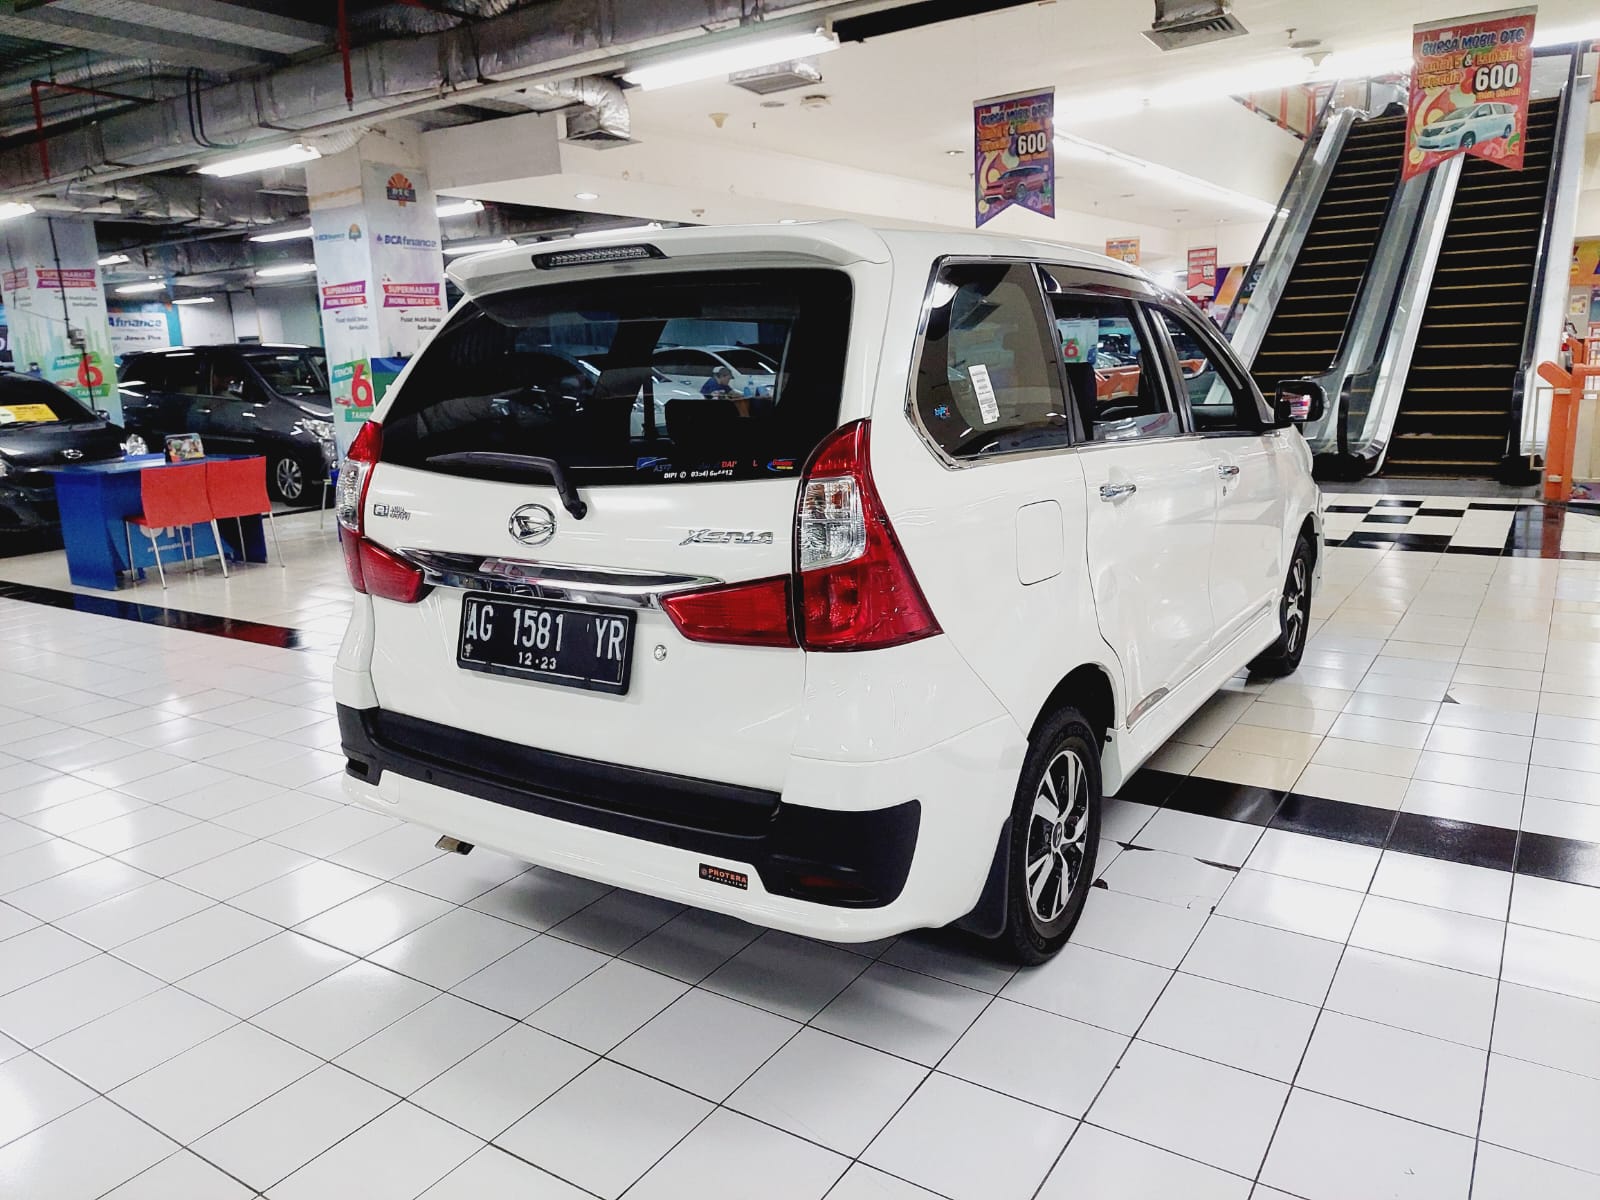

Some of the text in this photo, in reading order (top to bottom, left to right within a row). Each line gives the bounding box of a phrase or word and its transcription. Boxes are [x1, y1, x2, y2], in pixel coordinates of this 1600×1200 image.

[1462, 32, 1498, 49] MOBIL
[1474, 62, 1519, 92] 600
[1017, 131, 1047, 155] 600
[351, 363, 374, 408] 6
[466, 602, 625, 661] AG 1581 YR
[708, 868, 747, 884] PROTERA
